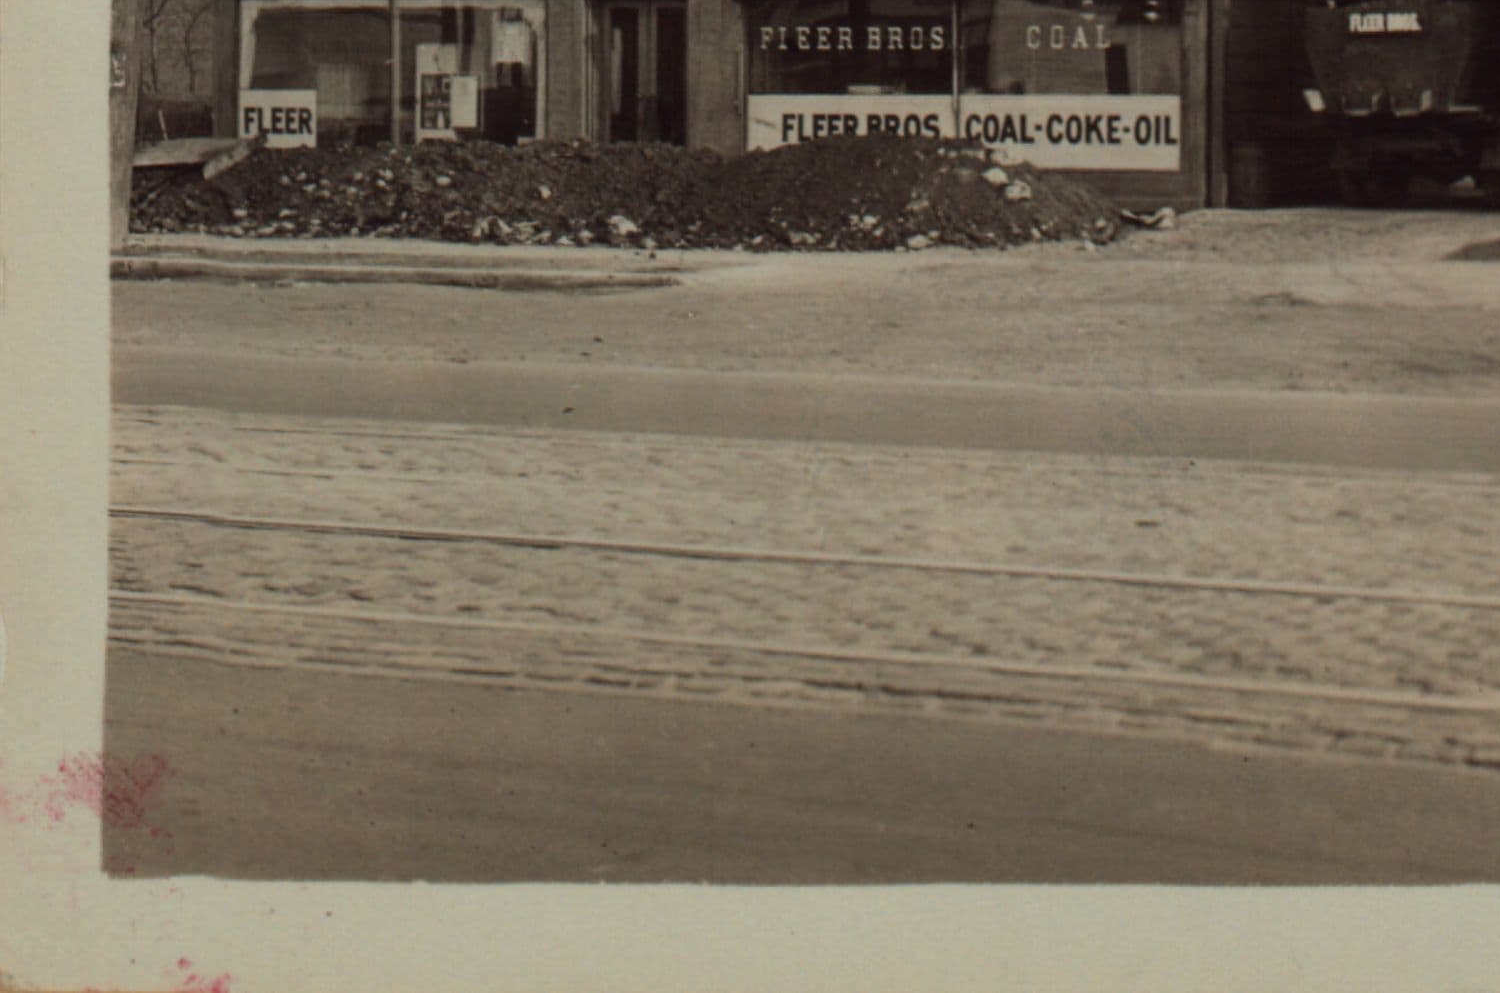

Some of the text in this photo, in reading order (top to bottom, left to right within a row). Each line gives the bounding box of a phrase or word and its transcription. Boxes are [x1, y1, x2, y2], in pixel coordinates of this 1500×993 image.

[1026, 24, 1112, 49] COAL
[243, 107, 313, 135] FLEER
[781, 112, 858, 142] FLEER
